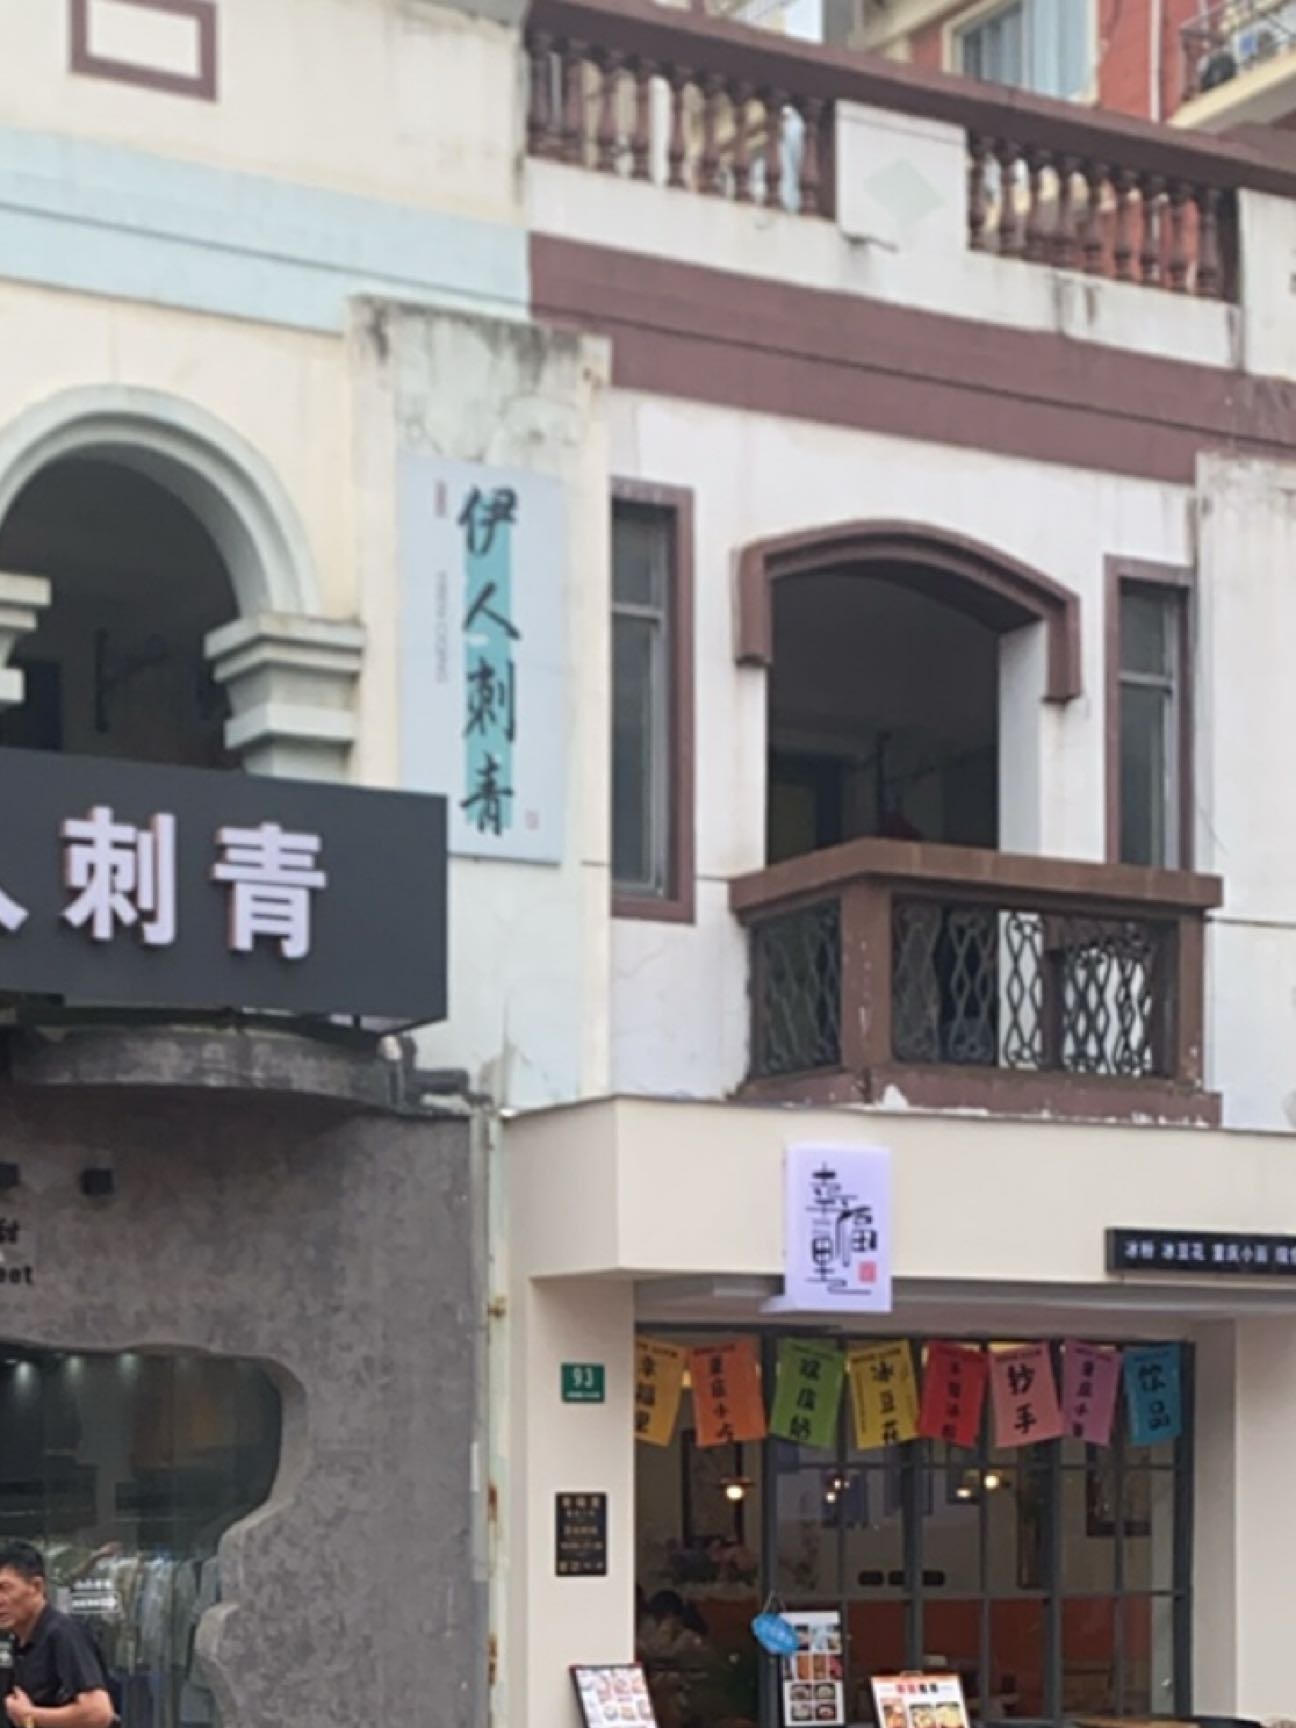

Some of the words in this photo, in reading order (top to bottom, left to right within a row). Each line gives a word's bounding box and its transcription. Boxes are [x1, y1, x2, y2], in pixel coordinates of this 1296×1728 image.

[457, 484, 522, 836] 伊人刺青
[572, 1367, 594, 1389] 93
[1138, 1364, 1171, 1432] 饮品
